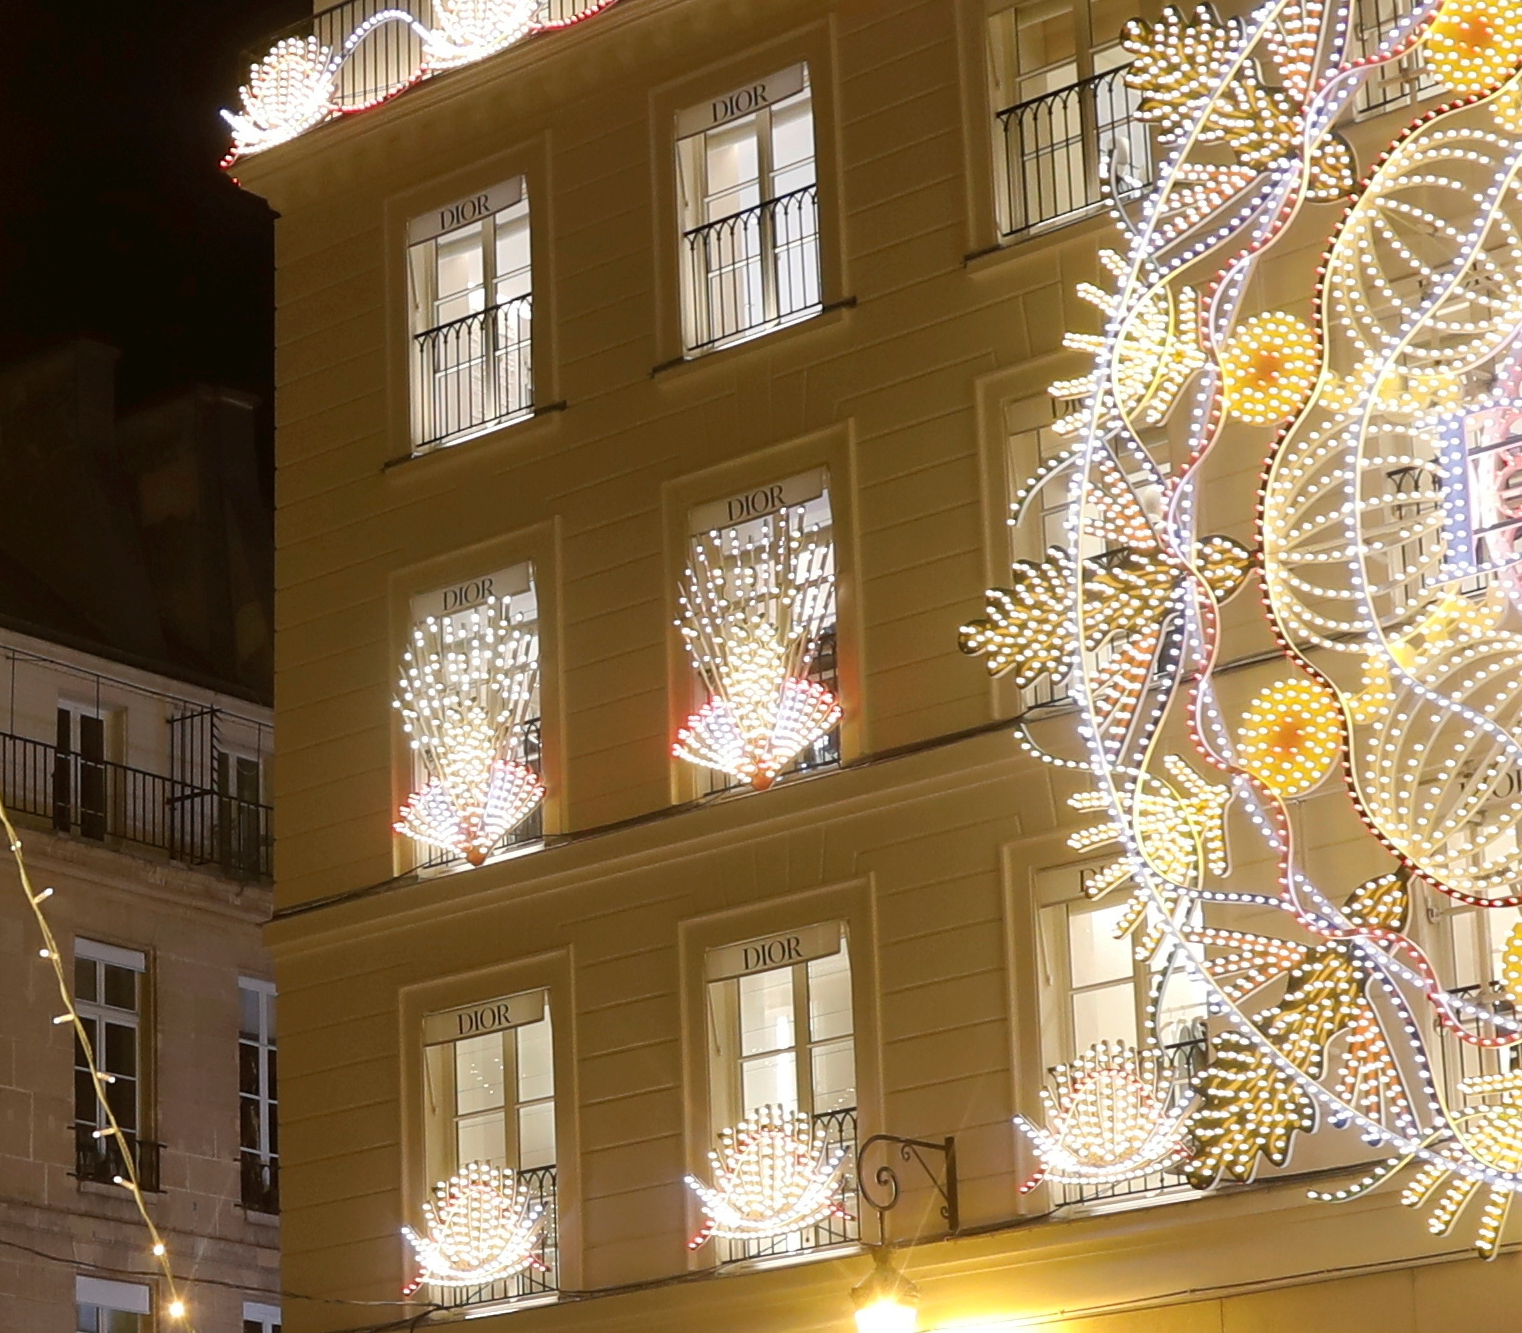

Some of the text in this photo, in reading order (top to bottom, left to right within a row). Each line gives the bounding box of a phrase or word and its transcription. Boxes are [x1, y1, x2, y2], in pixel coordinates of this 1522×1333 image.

[712, 84, 768, 122] DIOR
[439, 194, 491, 230] DIOR
[727, 484, 785, 521] DIOR
[444, 578, 495, 610] DIOR
[743, 937, 802, 969] DIOR
[458, 1004, 511, 1035] DIOR
